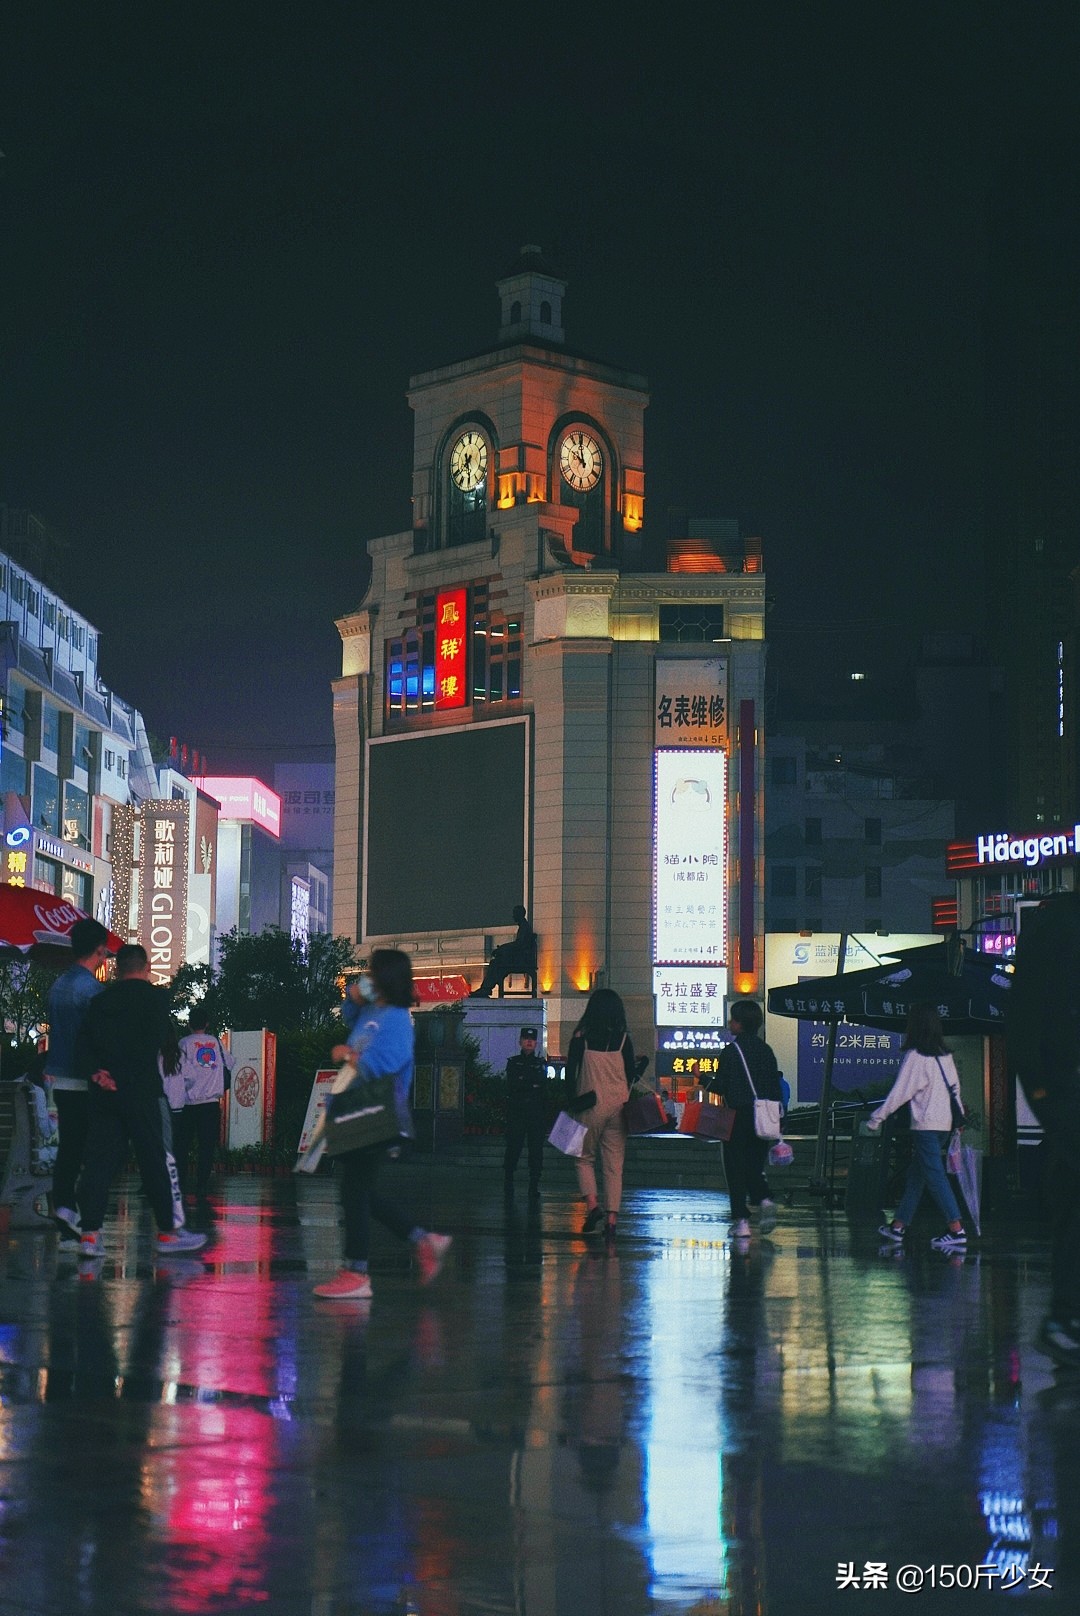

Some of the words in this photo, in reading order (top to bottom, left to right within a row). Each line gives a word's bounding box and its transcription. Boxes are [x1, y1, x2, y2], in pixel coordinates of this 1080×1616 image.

[657, 694, 725, 728] 名表维修
[711, 735, 724, 743] 5F
[977, 824, 1080, 866] Häagen-
[154, 819, 176, 889] 歌莉娅
[663, 854, 719, 866] 猫小院
[673, 871, 709, 882] (成都店)
[150, 893, 174, 987] GLORIA
[706, 945, 719, 954] 4F
[660, 982, 718, 997] 克拉盛宴
[667, 1001, 711, 1014] 珠宝定制
[711, 1016, 722, 1024] 2F
